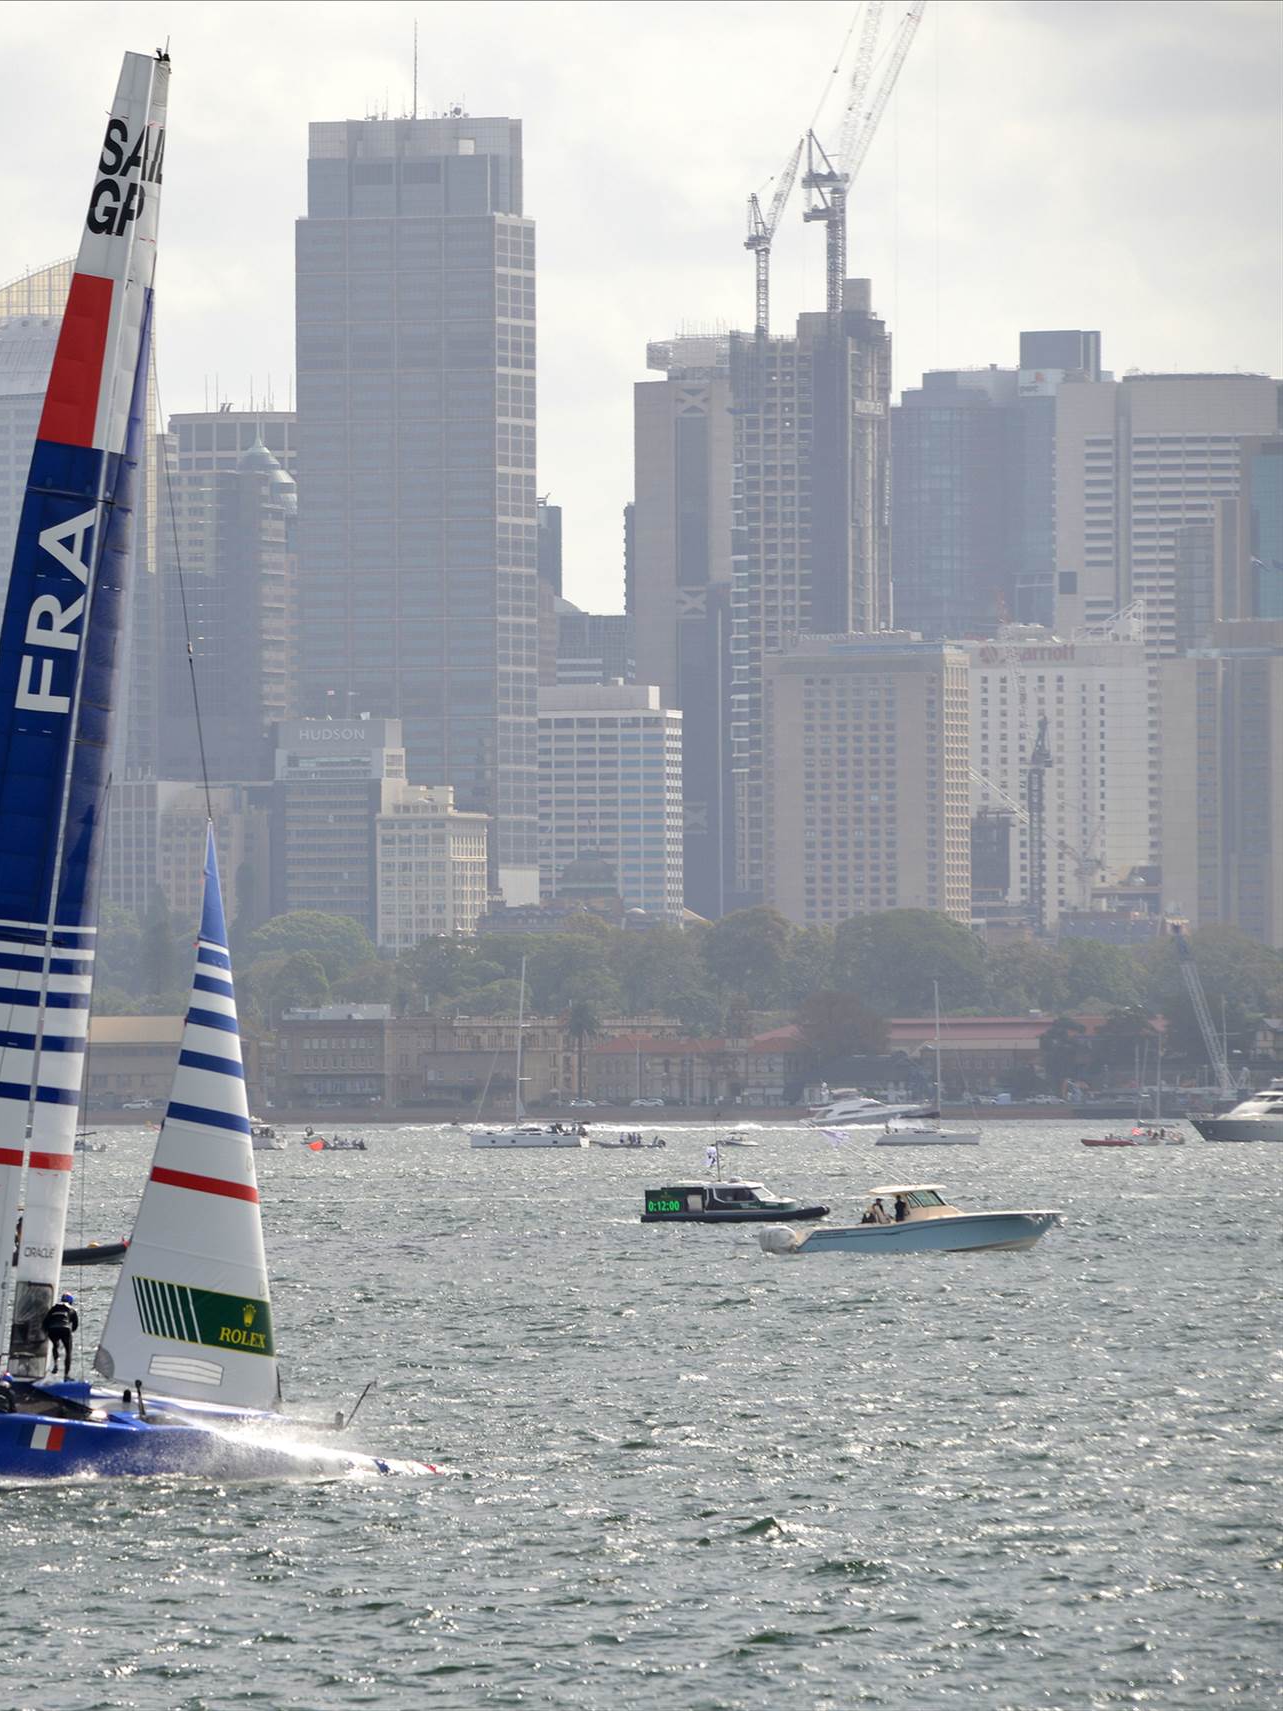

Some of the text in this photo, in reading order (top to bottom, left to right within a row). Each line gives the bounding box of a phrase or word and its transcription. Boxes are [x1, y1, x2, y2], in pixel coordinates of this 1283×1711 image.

[87, 178, 145, 236] GP
[15, 507, 97, 713] FRA
[299, 728, 365, 741] HUDSON
[648, 1200, 680, 1212] 0:12:00
[24, 1247, 56, 1259] ORACLE
[219, 1327, 267, 1349] ROLEX
